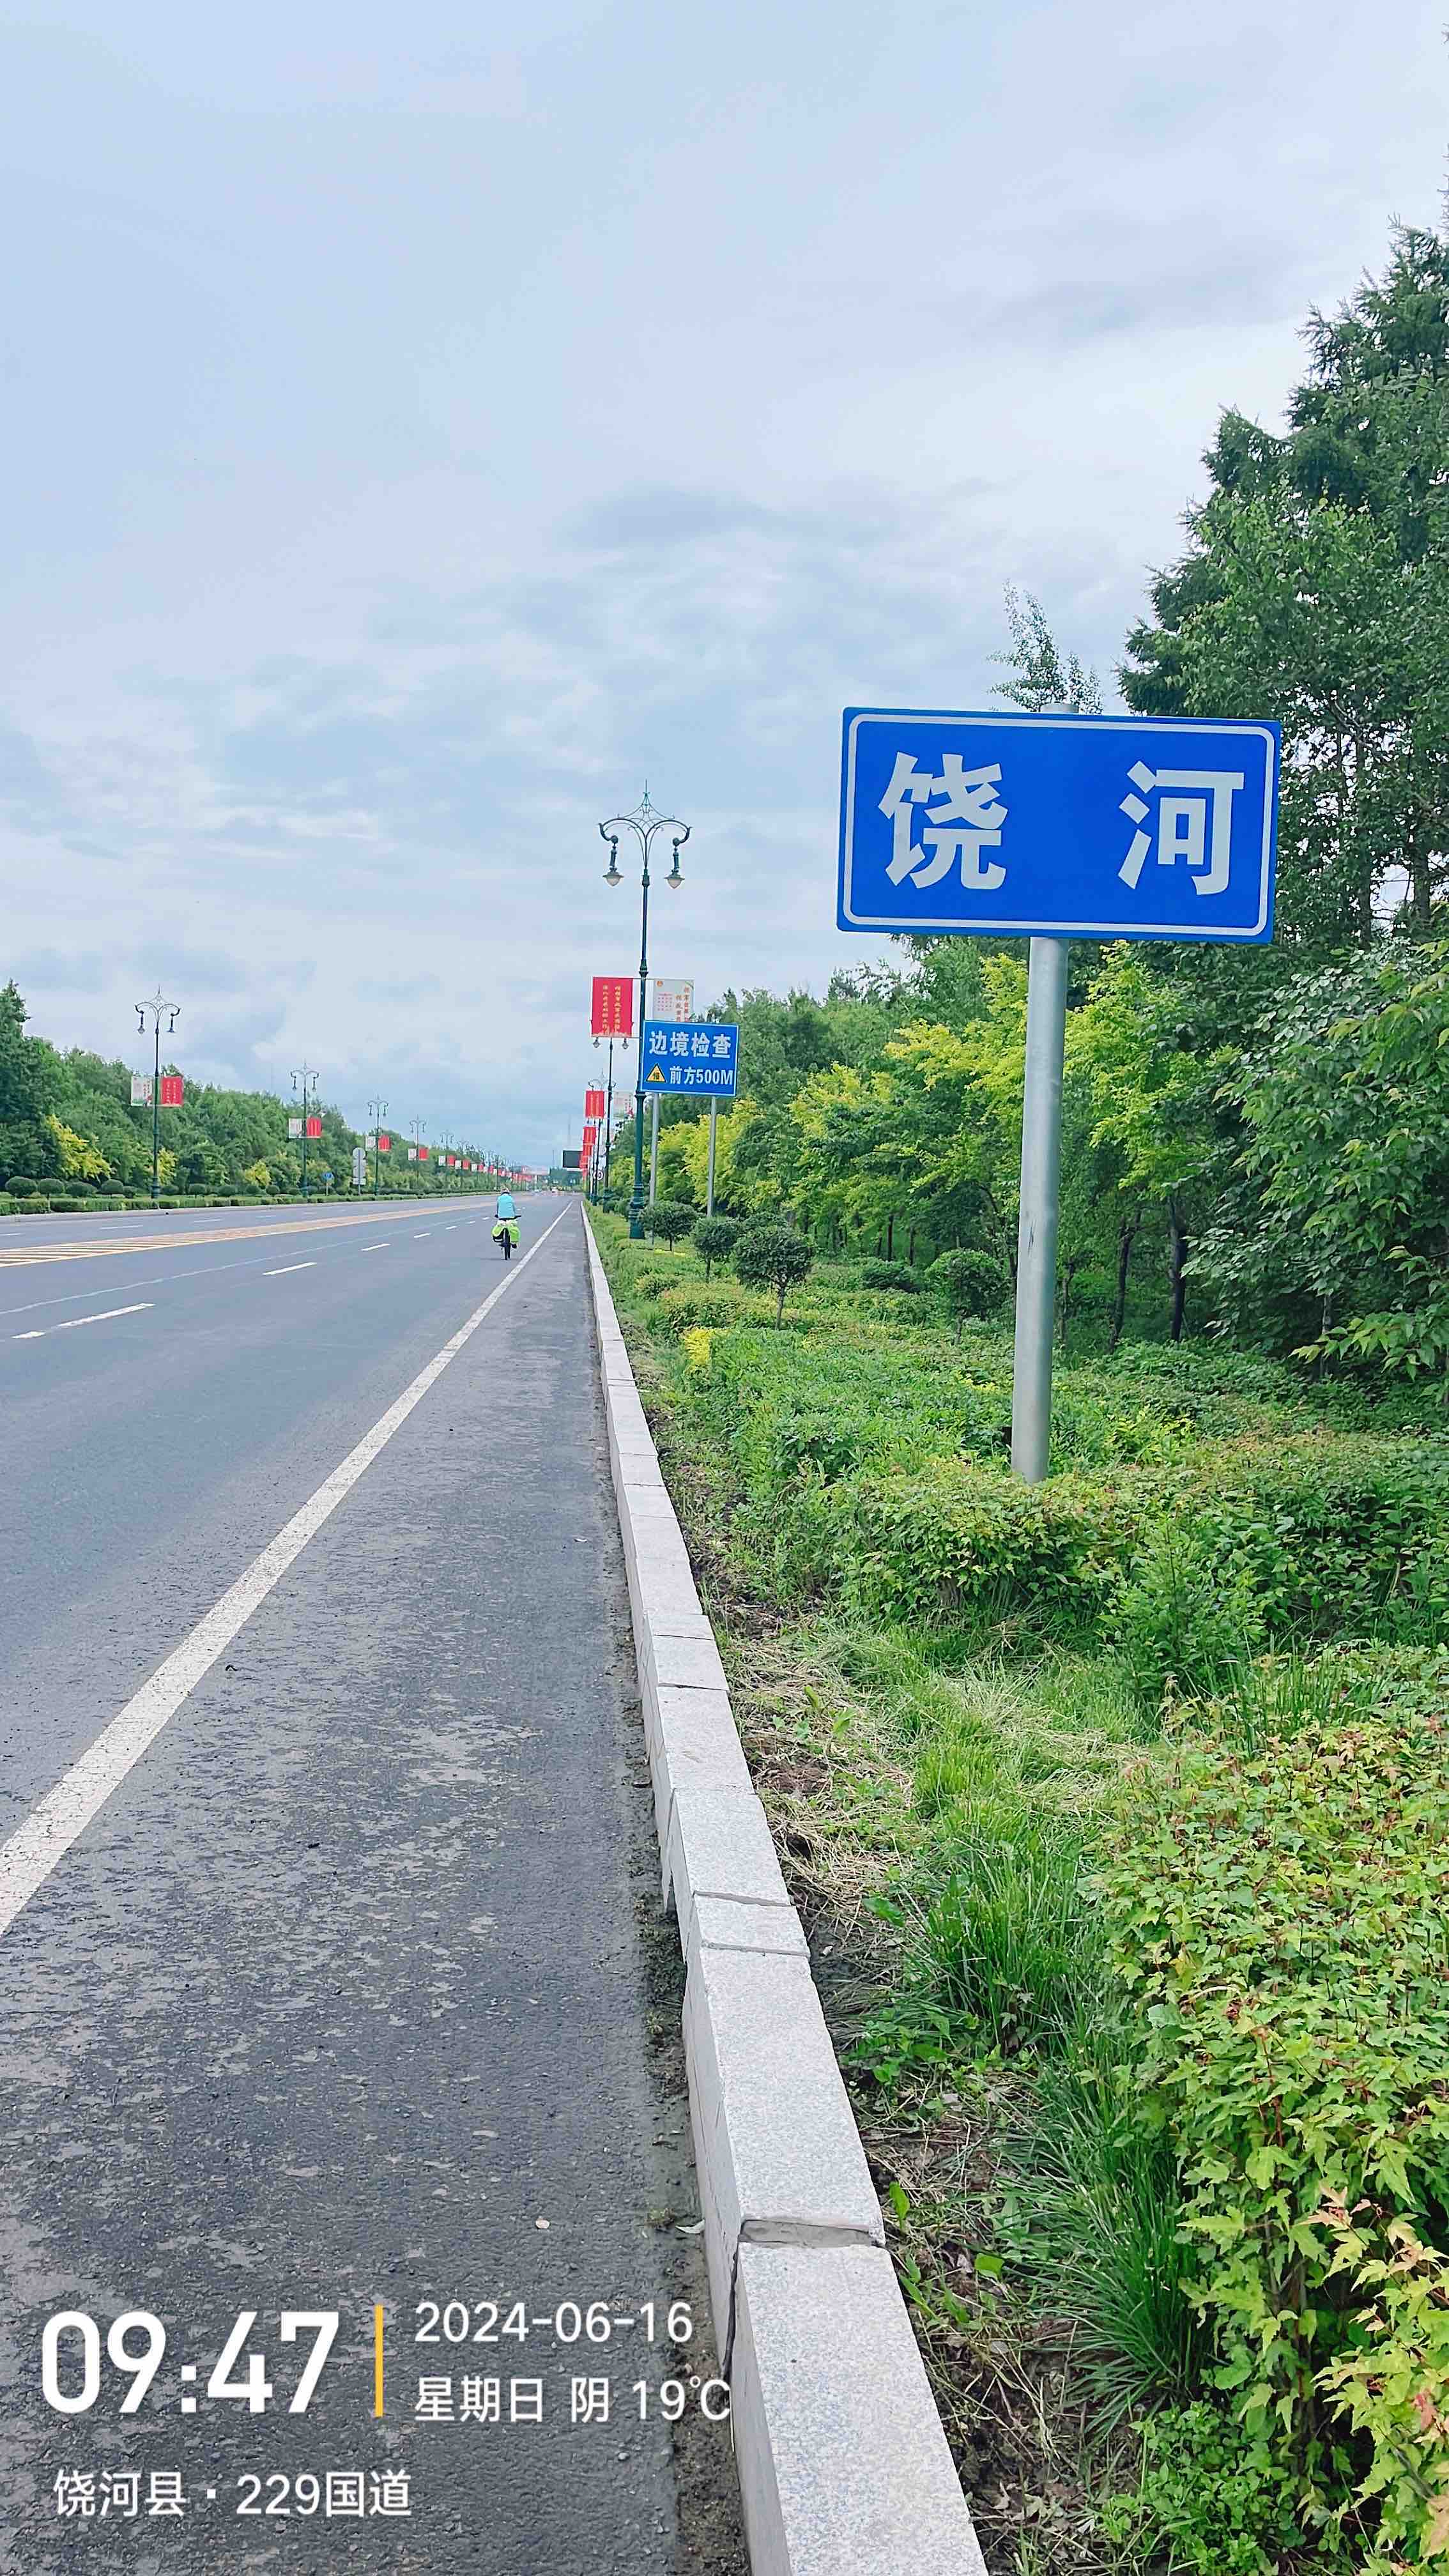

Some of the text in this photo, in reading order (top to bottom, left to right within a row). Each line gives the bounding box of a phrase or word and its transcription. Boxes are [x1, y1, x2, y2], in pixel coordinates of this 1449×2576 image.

[878, 751, 1245, 895] 饶河
[649, 1031, 732, 1058] 边境检查
[670, 1065, 733, 1085] 前方500M
